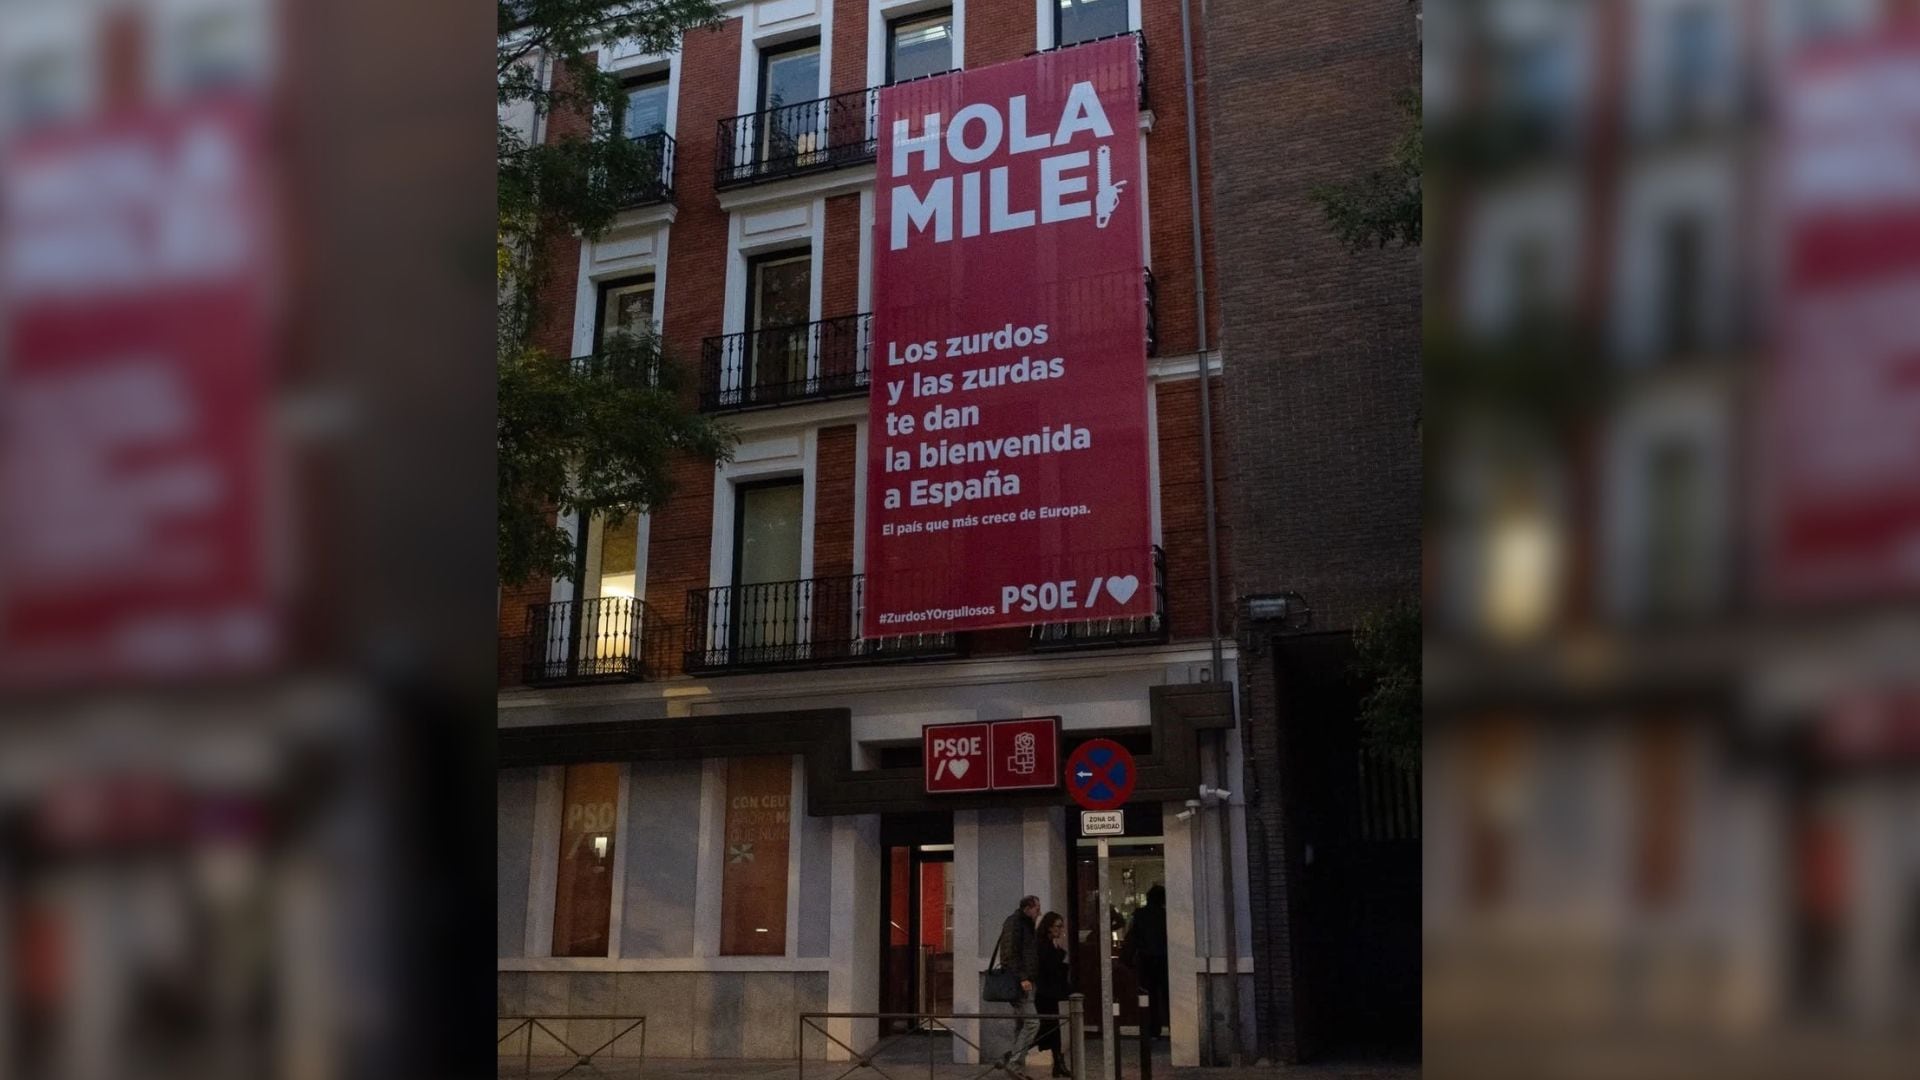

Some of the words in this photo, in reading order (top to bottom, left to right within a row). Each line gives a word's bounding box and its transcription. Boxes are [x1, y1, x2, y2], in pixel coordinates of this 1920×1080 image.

[892, 81, 1114, 177] HOLA
[888, 341, 938, 366] Los
[946, 323, 1048, 358] zurdos
[887, 380, 904, 405] y
[913, 372, 953, 397] las
[962, 356, 1065, 391] zurdas
[886, 412, 915, 436] te
[923, 404, 980, 431] dan
[885, 447, 911, 472] la
[919, 424, 1091, 469] bienvenida
[884, 488, 901, 509] a
[910, 470, 1020, 508] España
[882, 523, 894, 536] El
[897, 520, 923, 536] país
[926, 519, 949, 533] que
[952, 514, 979, 528] más
[981, 510, 1017, 525] crece
[1019, 507, 1036, 521] de
[1039, 504, 1091, 519] Europa.
[879, 604, 996, 625] #ZurdosYOrgullosos
[1001, 580, 1078, 614] PSOE
[933, 736, 982, 758] PSOE
[732, 795, 759, 809] CON
[1086, 823, 1120, 831] SEGURIDAD
